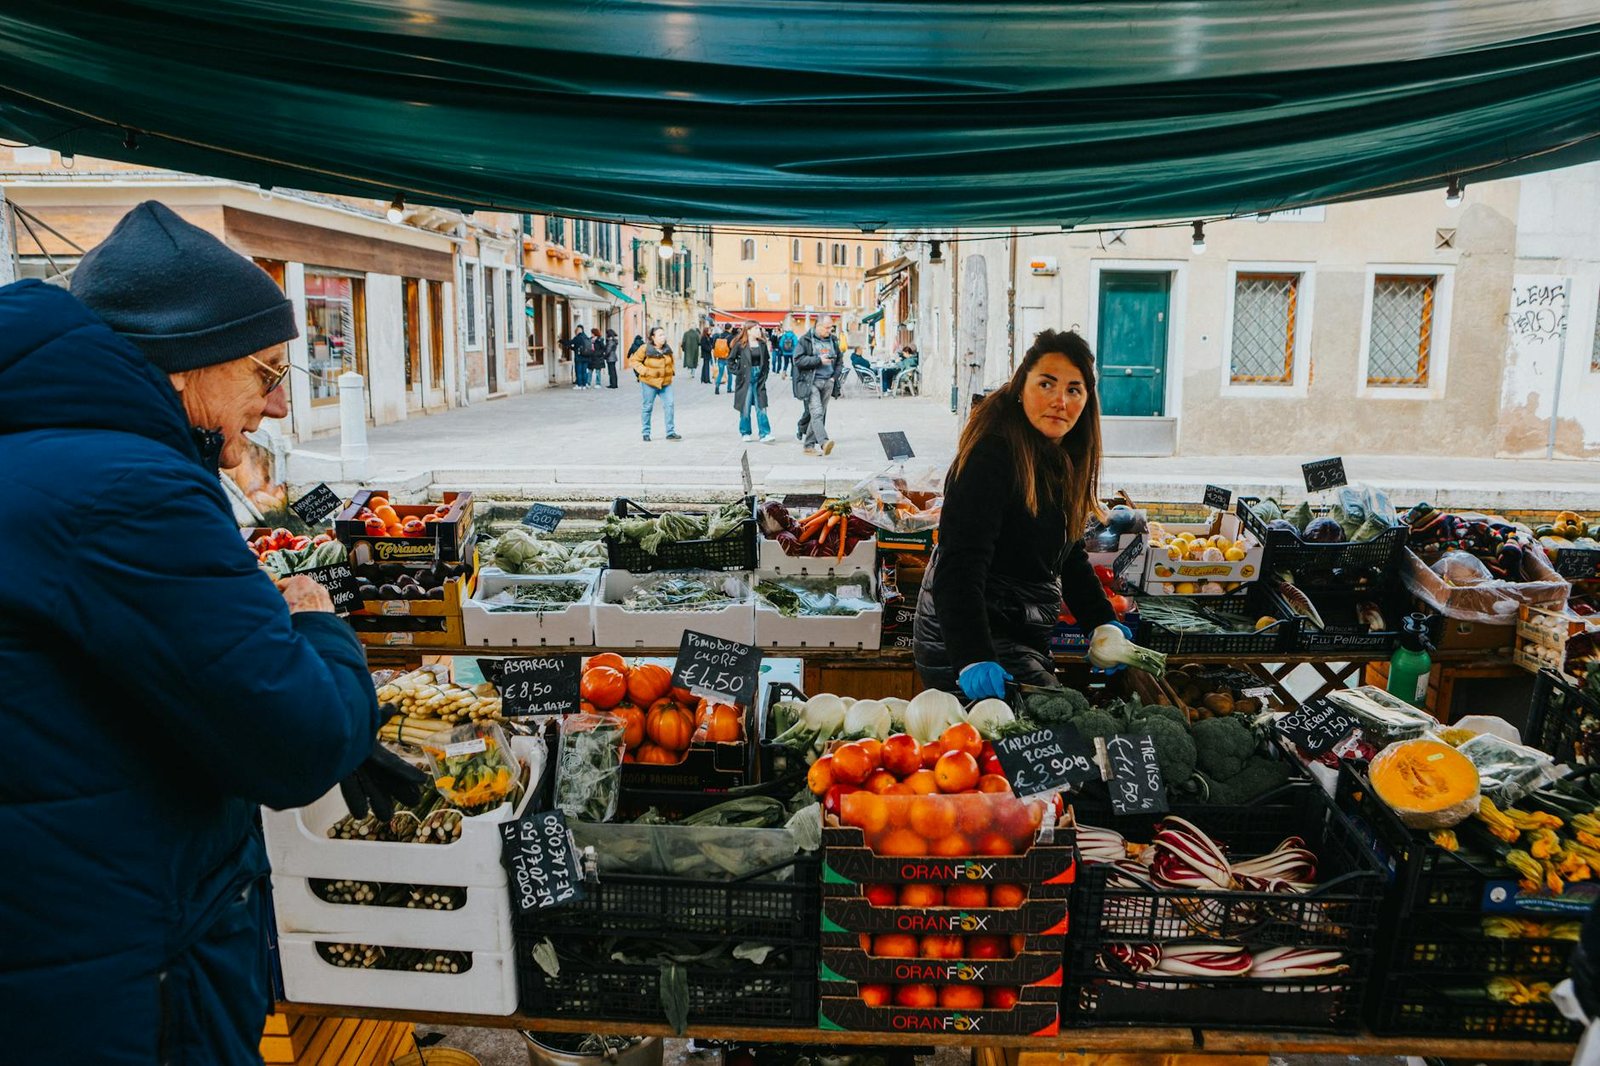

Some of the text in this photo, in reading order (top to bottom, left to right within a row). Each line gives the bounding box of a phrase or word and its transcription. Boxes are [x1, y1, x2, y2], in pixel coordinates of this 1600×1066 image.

[504, 658, 564, 675] ASPARAGI
[694, 651, 738, 668] CUORE
[528, 703, 542, 714] AL
[1276, 704, 1315, 734] ROSA
[1300, 706, 1336, 731] VERONA
[998, 728, 1053, 754] TAROCCO
[1022, 743, 1064, 764] ROSSA
[512, 854, 537, 909] BOTOLI
